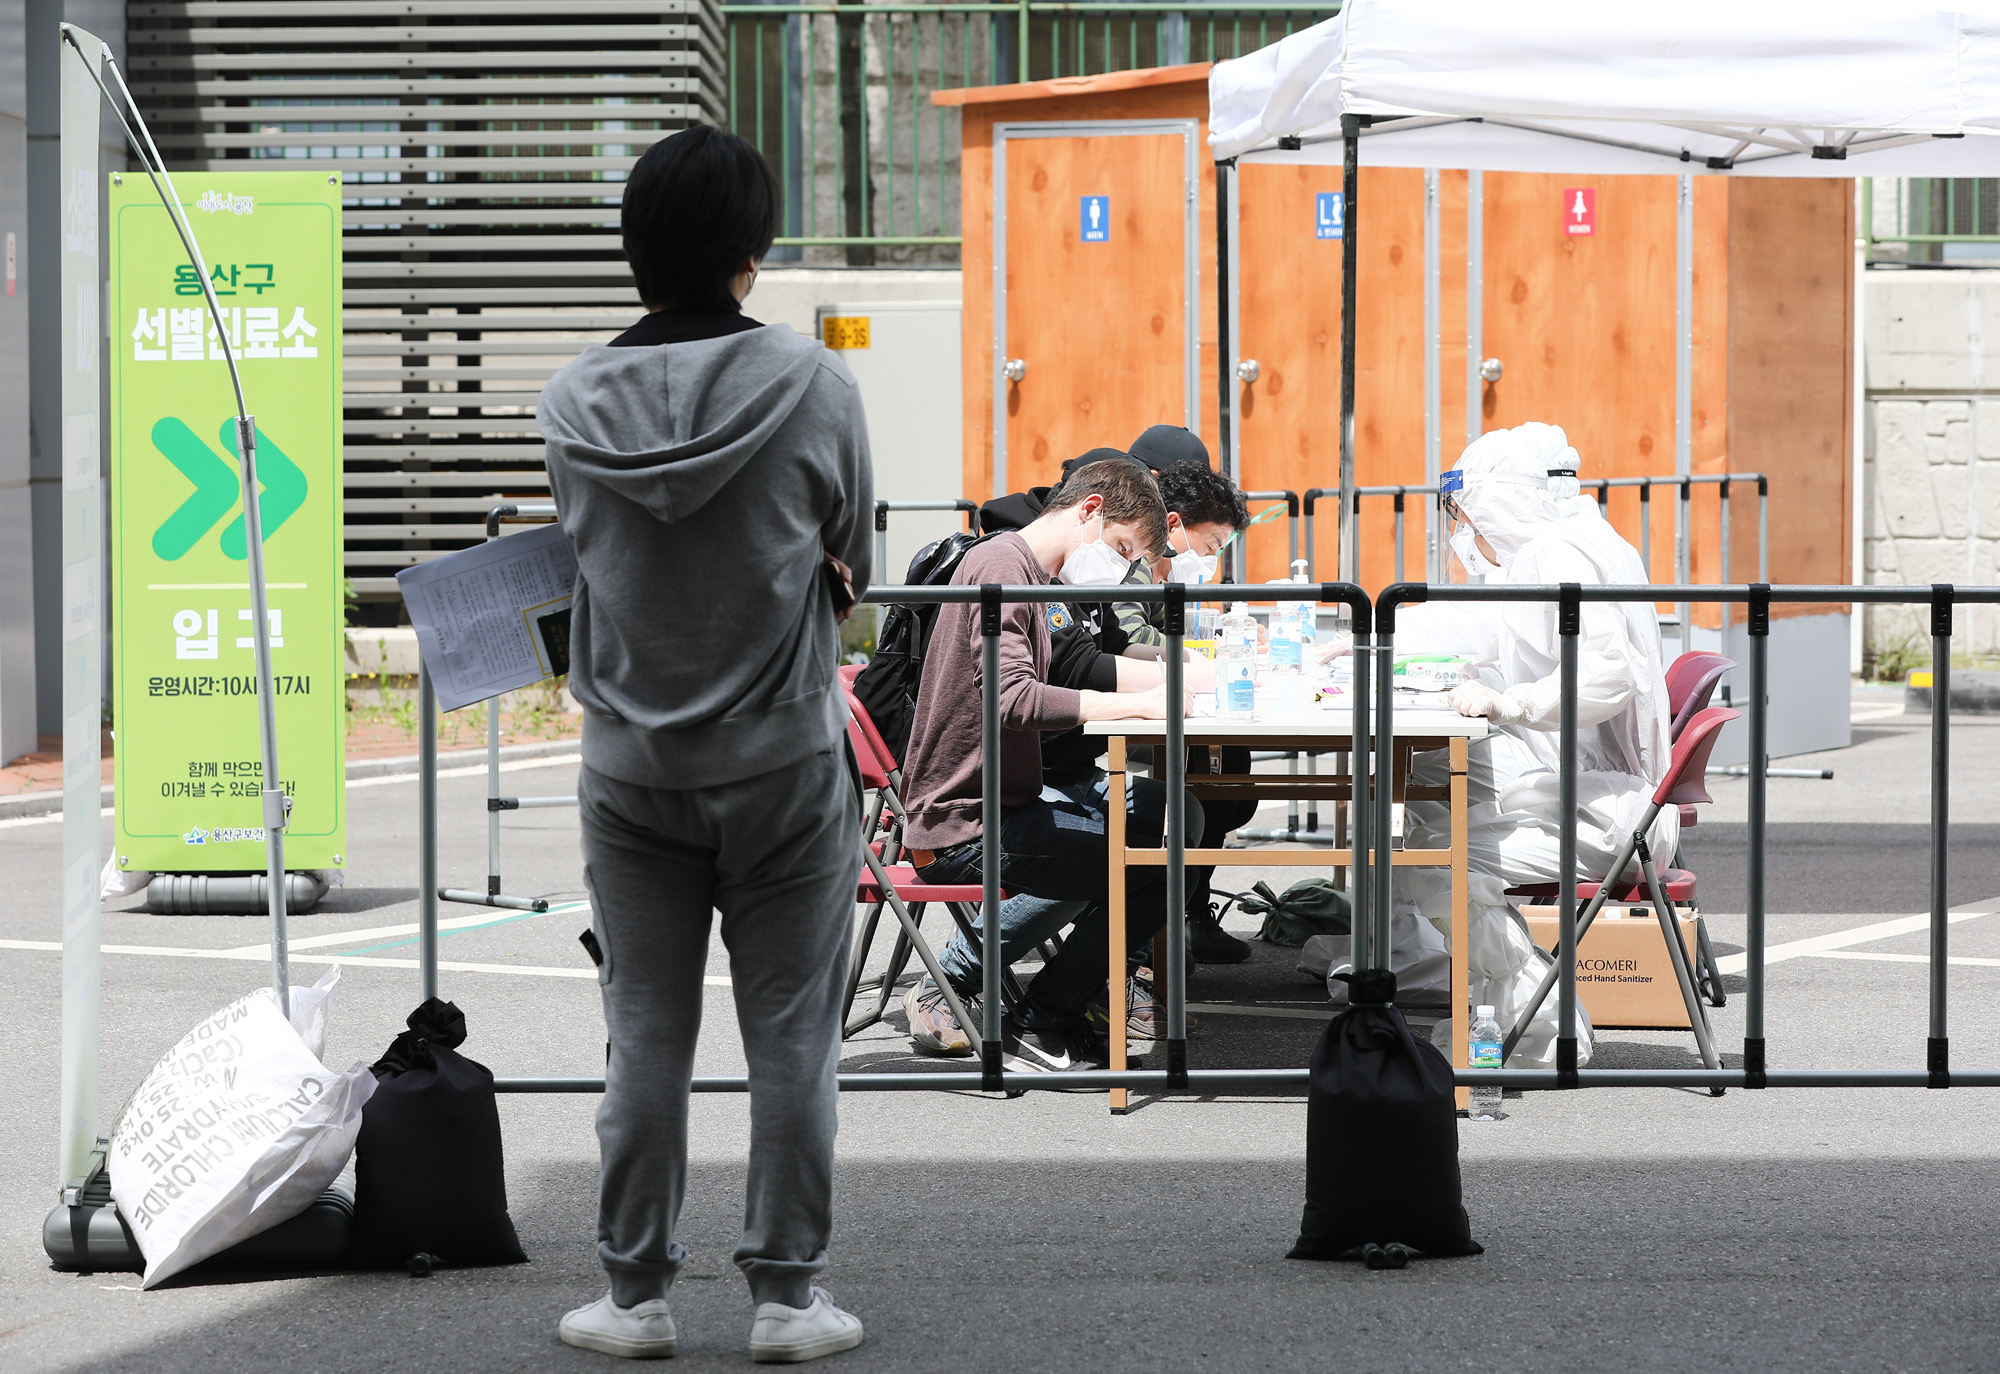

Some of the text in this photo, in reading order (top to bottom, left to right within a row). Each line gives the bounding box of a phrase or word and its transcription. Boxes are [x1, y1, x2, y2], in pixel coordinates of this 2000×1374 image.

[173, 264, 276, 296] 용산구
[131, 306, 318, 361] 선별진료소
[188, 761, 218, 778] 함께
[161, 780, 295, 798] 이겨낼 수 있습다!
[212, 828, 266, 843] 용산구보건
[1575, 959, 1638, 971] ACOMERI
[1594, 974, 1616, 982] Hand
[1617, 974, 1653, 983] Sanitizer
[184, 1004, 248, 1047] MADE
[226, 1077, 323, 1146] CALCIUM
[134, 1135, 234, 1231] CHLORIDE
